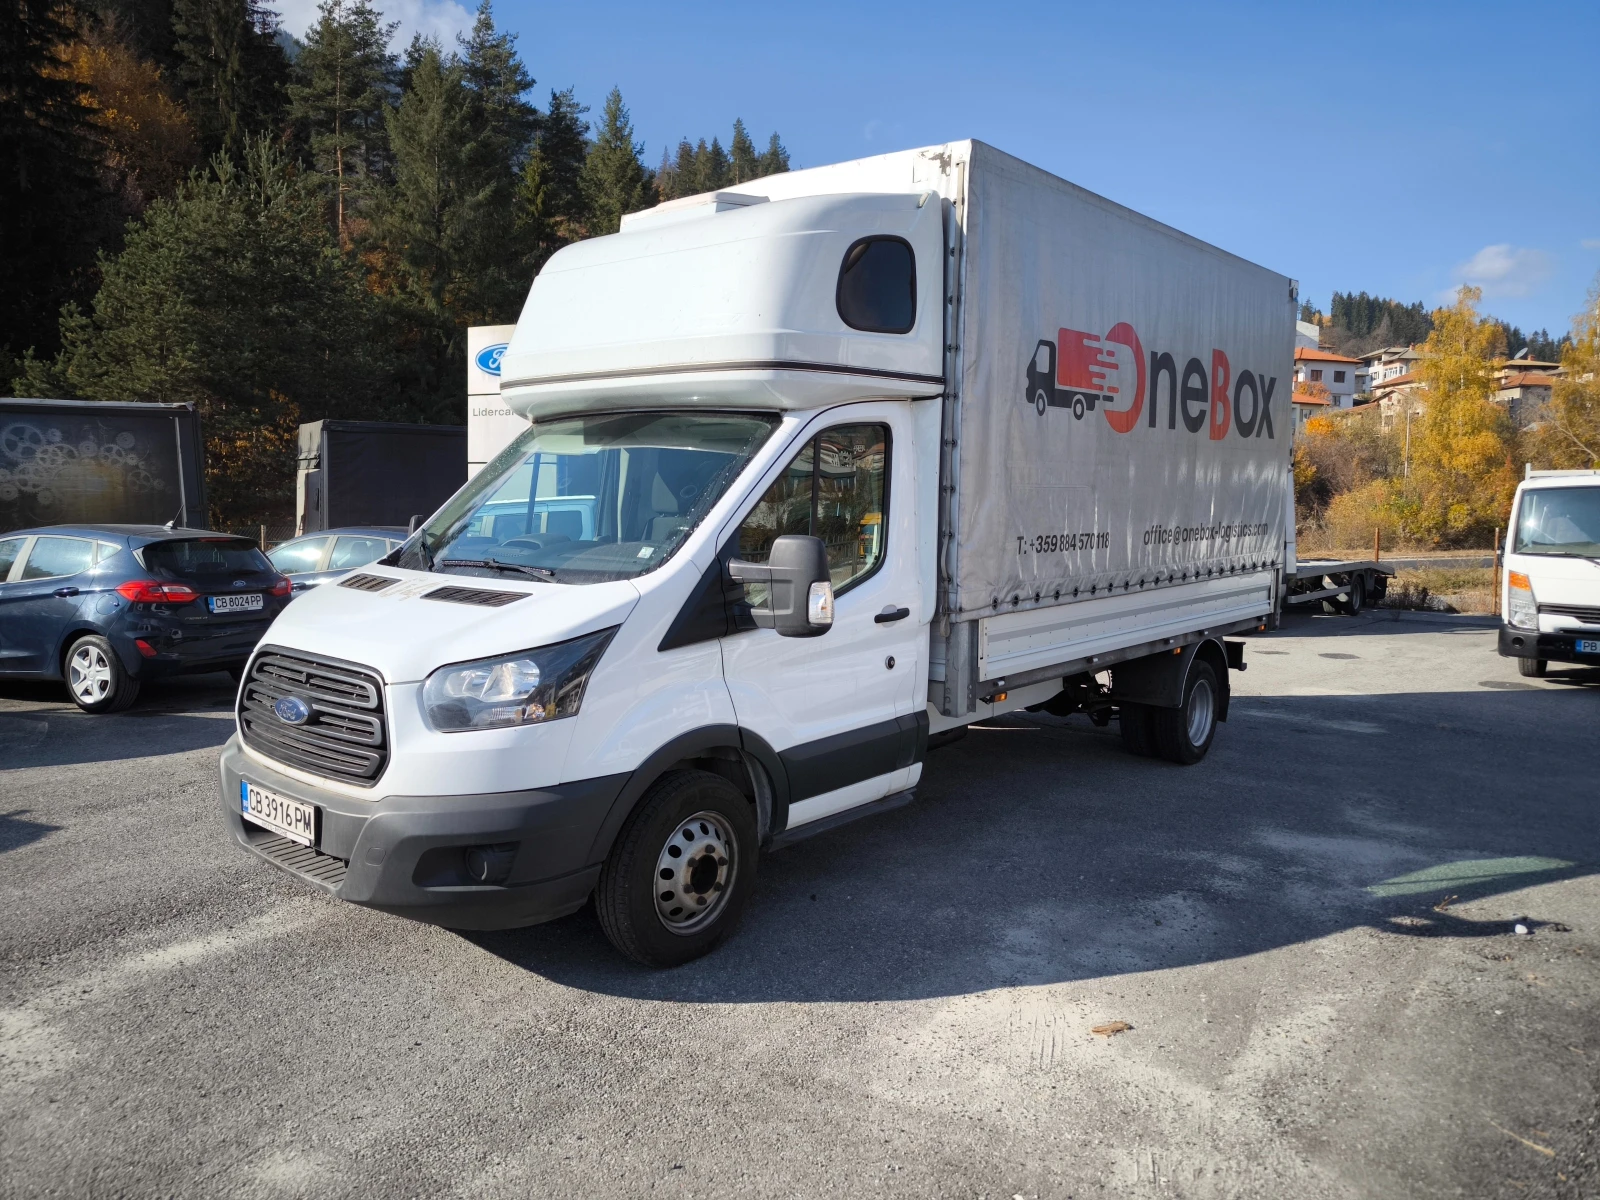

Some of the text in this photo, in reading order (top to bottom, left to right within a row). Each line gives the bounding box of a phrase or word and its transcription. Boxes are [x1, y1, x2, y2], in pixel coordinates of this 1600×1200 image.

[1103, 322, 1277, 441] OneBox
[1017, 535, 1027, 555] T:
[215, 597, 228, 608] CB
[1583, 641, 1598, 652] PB
[249, 788, 263, 815] CB
